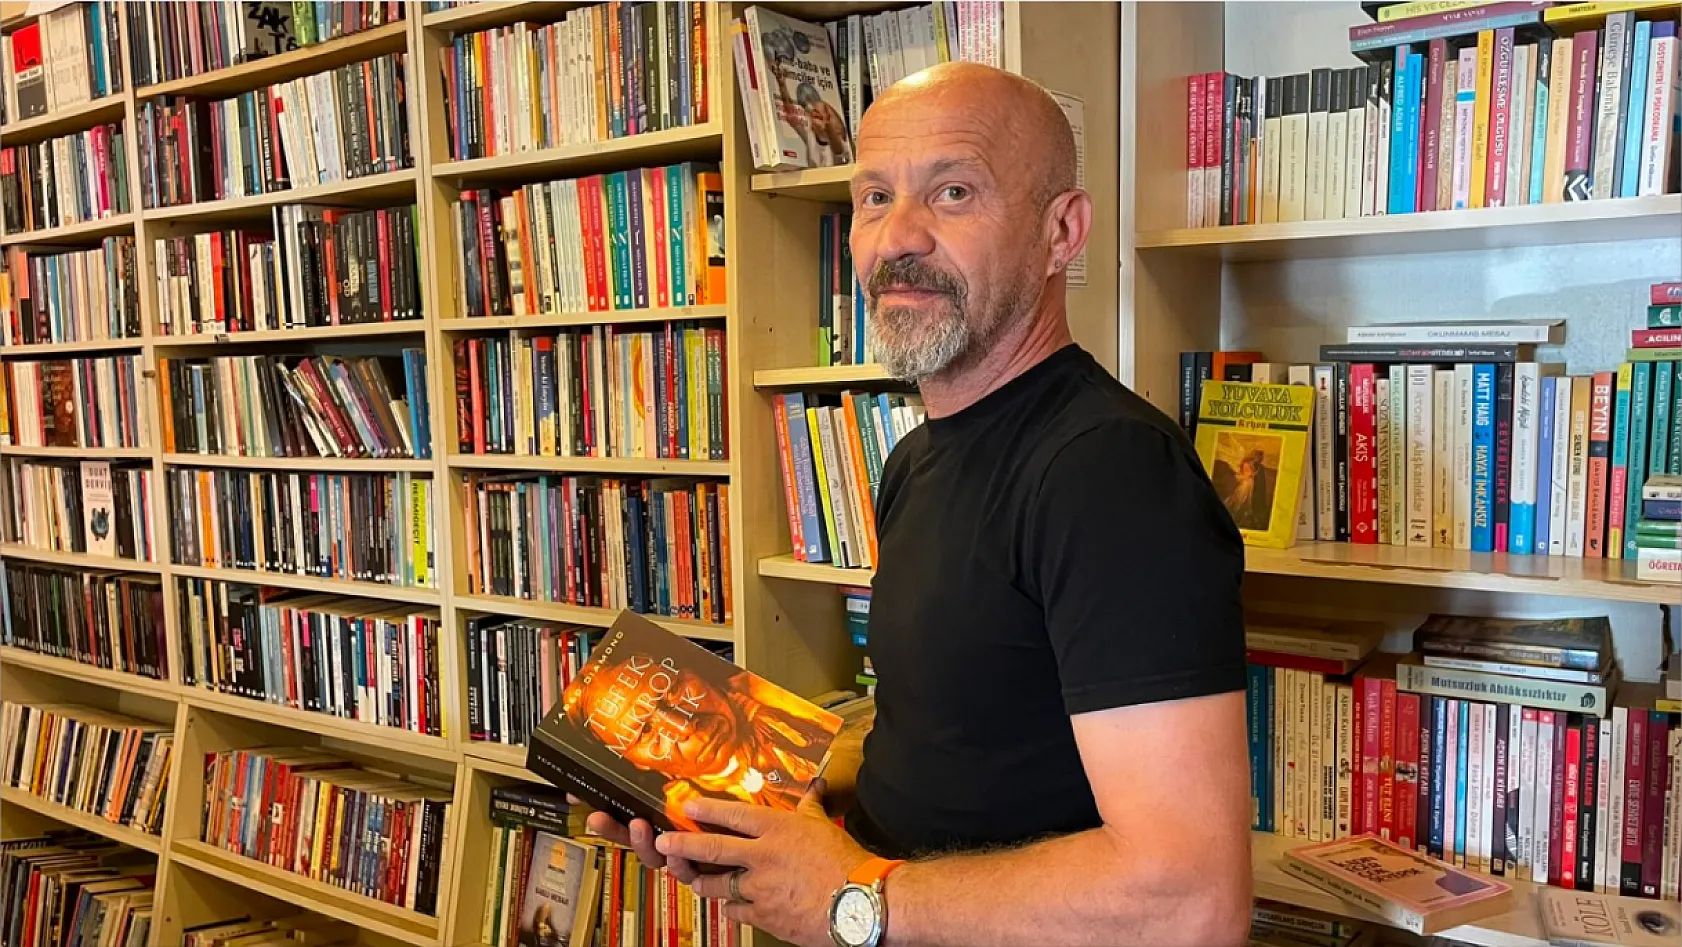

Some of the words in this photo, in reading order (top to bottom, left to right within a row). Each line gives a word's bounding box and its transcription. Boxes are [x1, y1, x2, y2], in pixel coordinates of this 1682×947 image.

[1607, 22, 1622, 68] Güneşe
[1396, 75, 1405, 105] ALFRED
[1603, 72, 1619, 120] Bakmak
[1654, 87, 1663, 96] VE
[1395, 107, 1404, 132] ADLER
[1495, 113, 1506, 157] OLGUSU
[1222, 384, 1292, 403] YUVAYA
[1477, 373, 1490, 400] MATT
[1208, 400, 1302, 421] YOLCULUK
[1413, 391, 1426, 437] Atomik
[1476, 402, 1489, 426] HAIG
[1353, 433, 1368, 462] AKIŞ
[1475, 445, 1488, 477] HAYAT
[1497, 420, 1509, 505] SEVEBİLMEK
[1410, 440, 1428, 512] Alışkanlıklar
[1474, 479, 1490, 528] İMKÂNSIZ
[583, 631, 624, 684] DIAMOND
[1431, 676, 1488, 693] Mutsuzluk
[604, 656, 680, 759] MİKROP
[647, 688, 707, 761] ÇELİK
[1496, 739, 1505, 764] AŞKIN
[1586, 724, 1595, 759] NASIL
[1420, 767, 1430, 796] KİTABI
[1496, 778, 1506, 809] KİTABI
[1574, 897, 1614, 937] KÖLE
